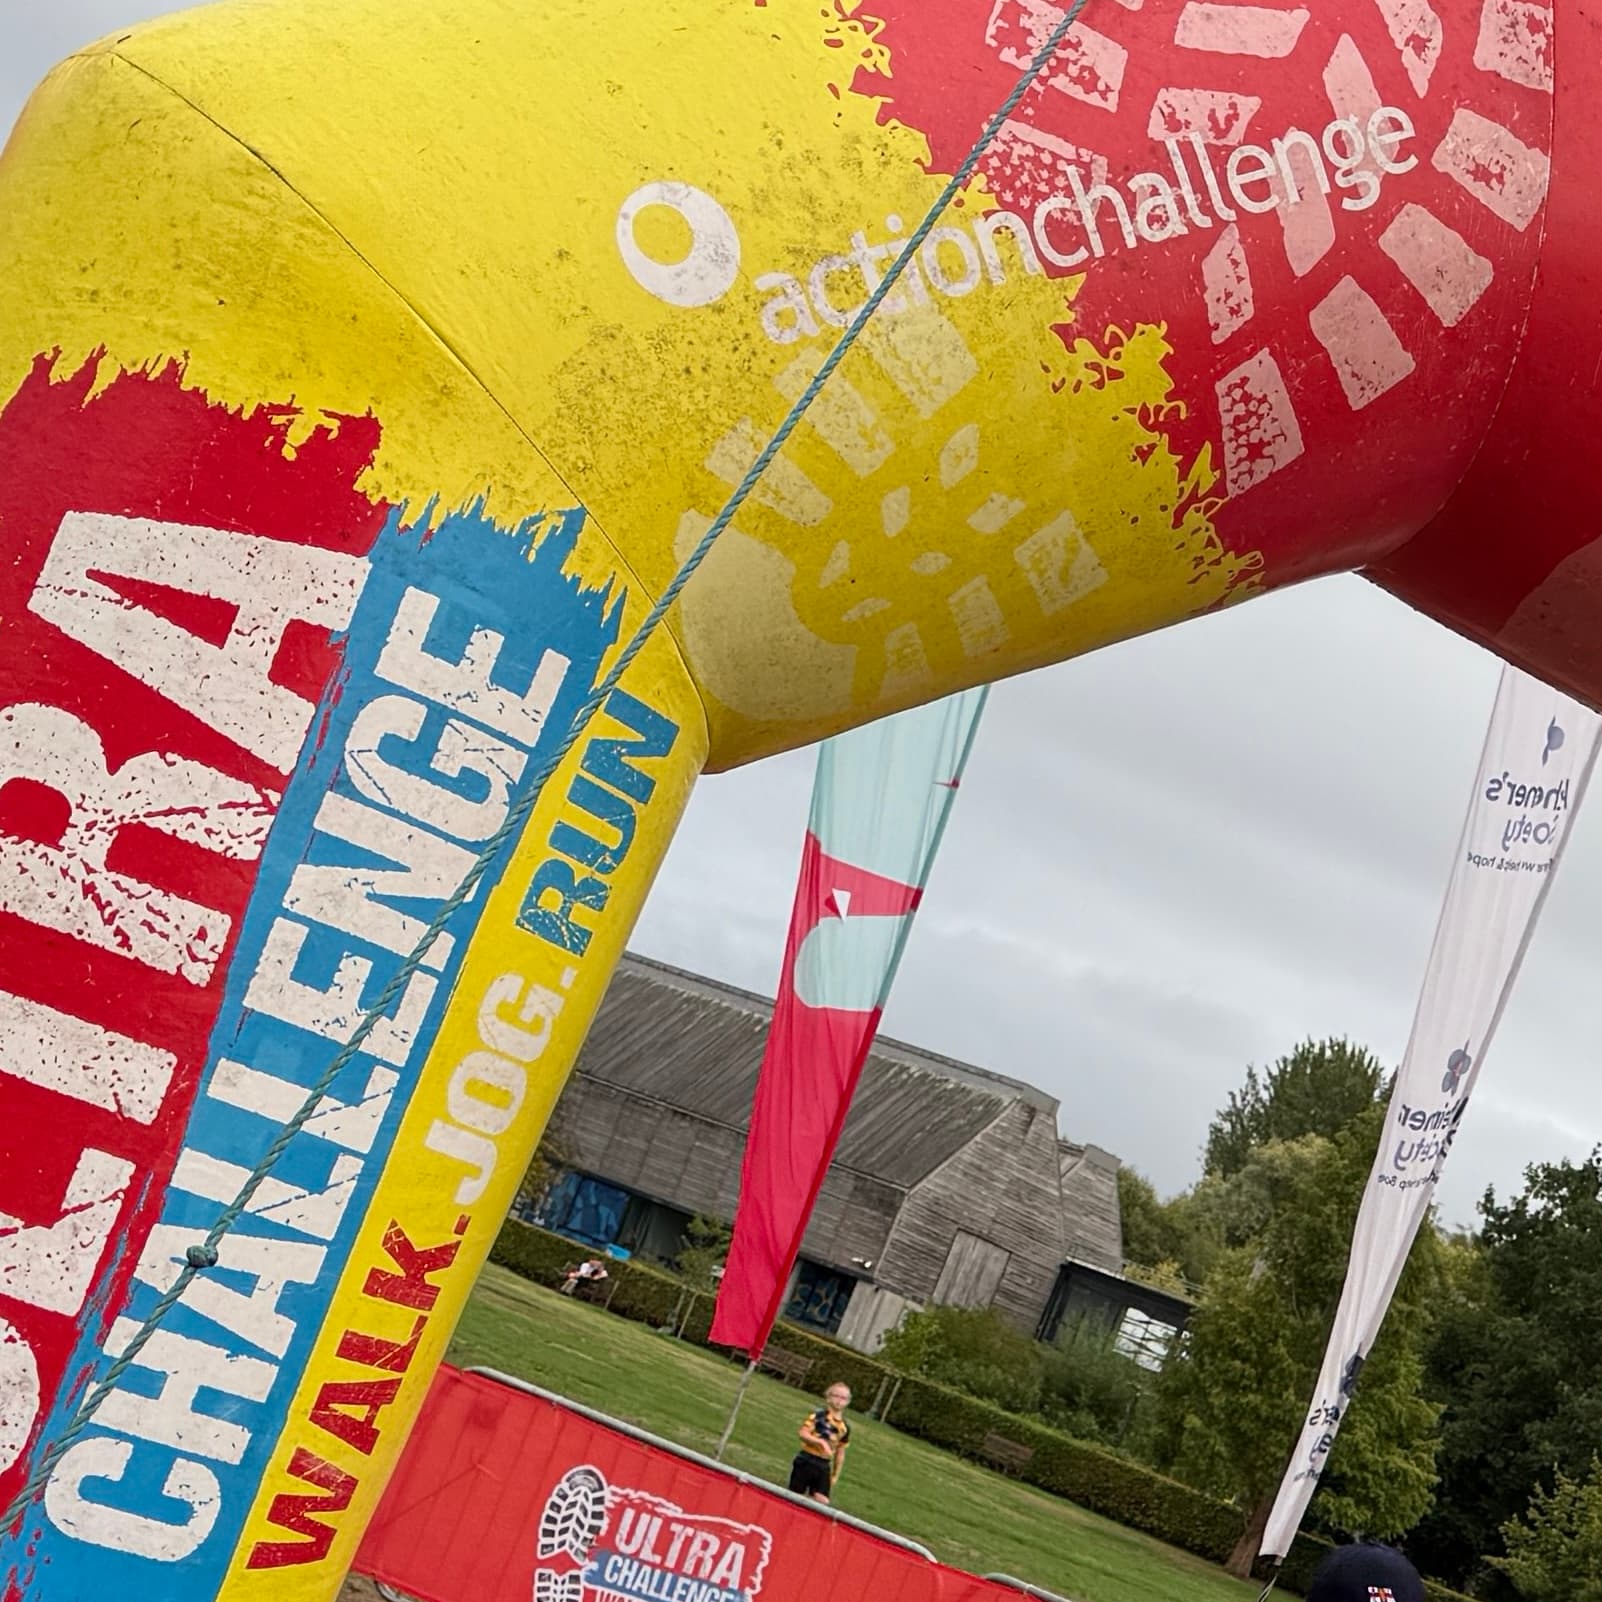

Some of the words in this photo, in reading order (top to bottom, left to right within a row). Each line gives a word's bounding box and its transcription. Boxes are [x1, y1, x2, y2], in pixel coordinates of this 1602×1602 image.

[754, 105, 1417, 346] actionchallenge
[44, 586, 571, 1562] CHALLENGE
[615, 1507, 746, 1589] ULTRA
